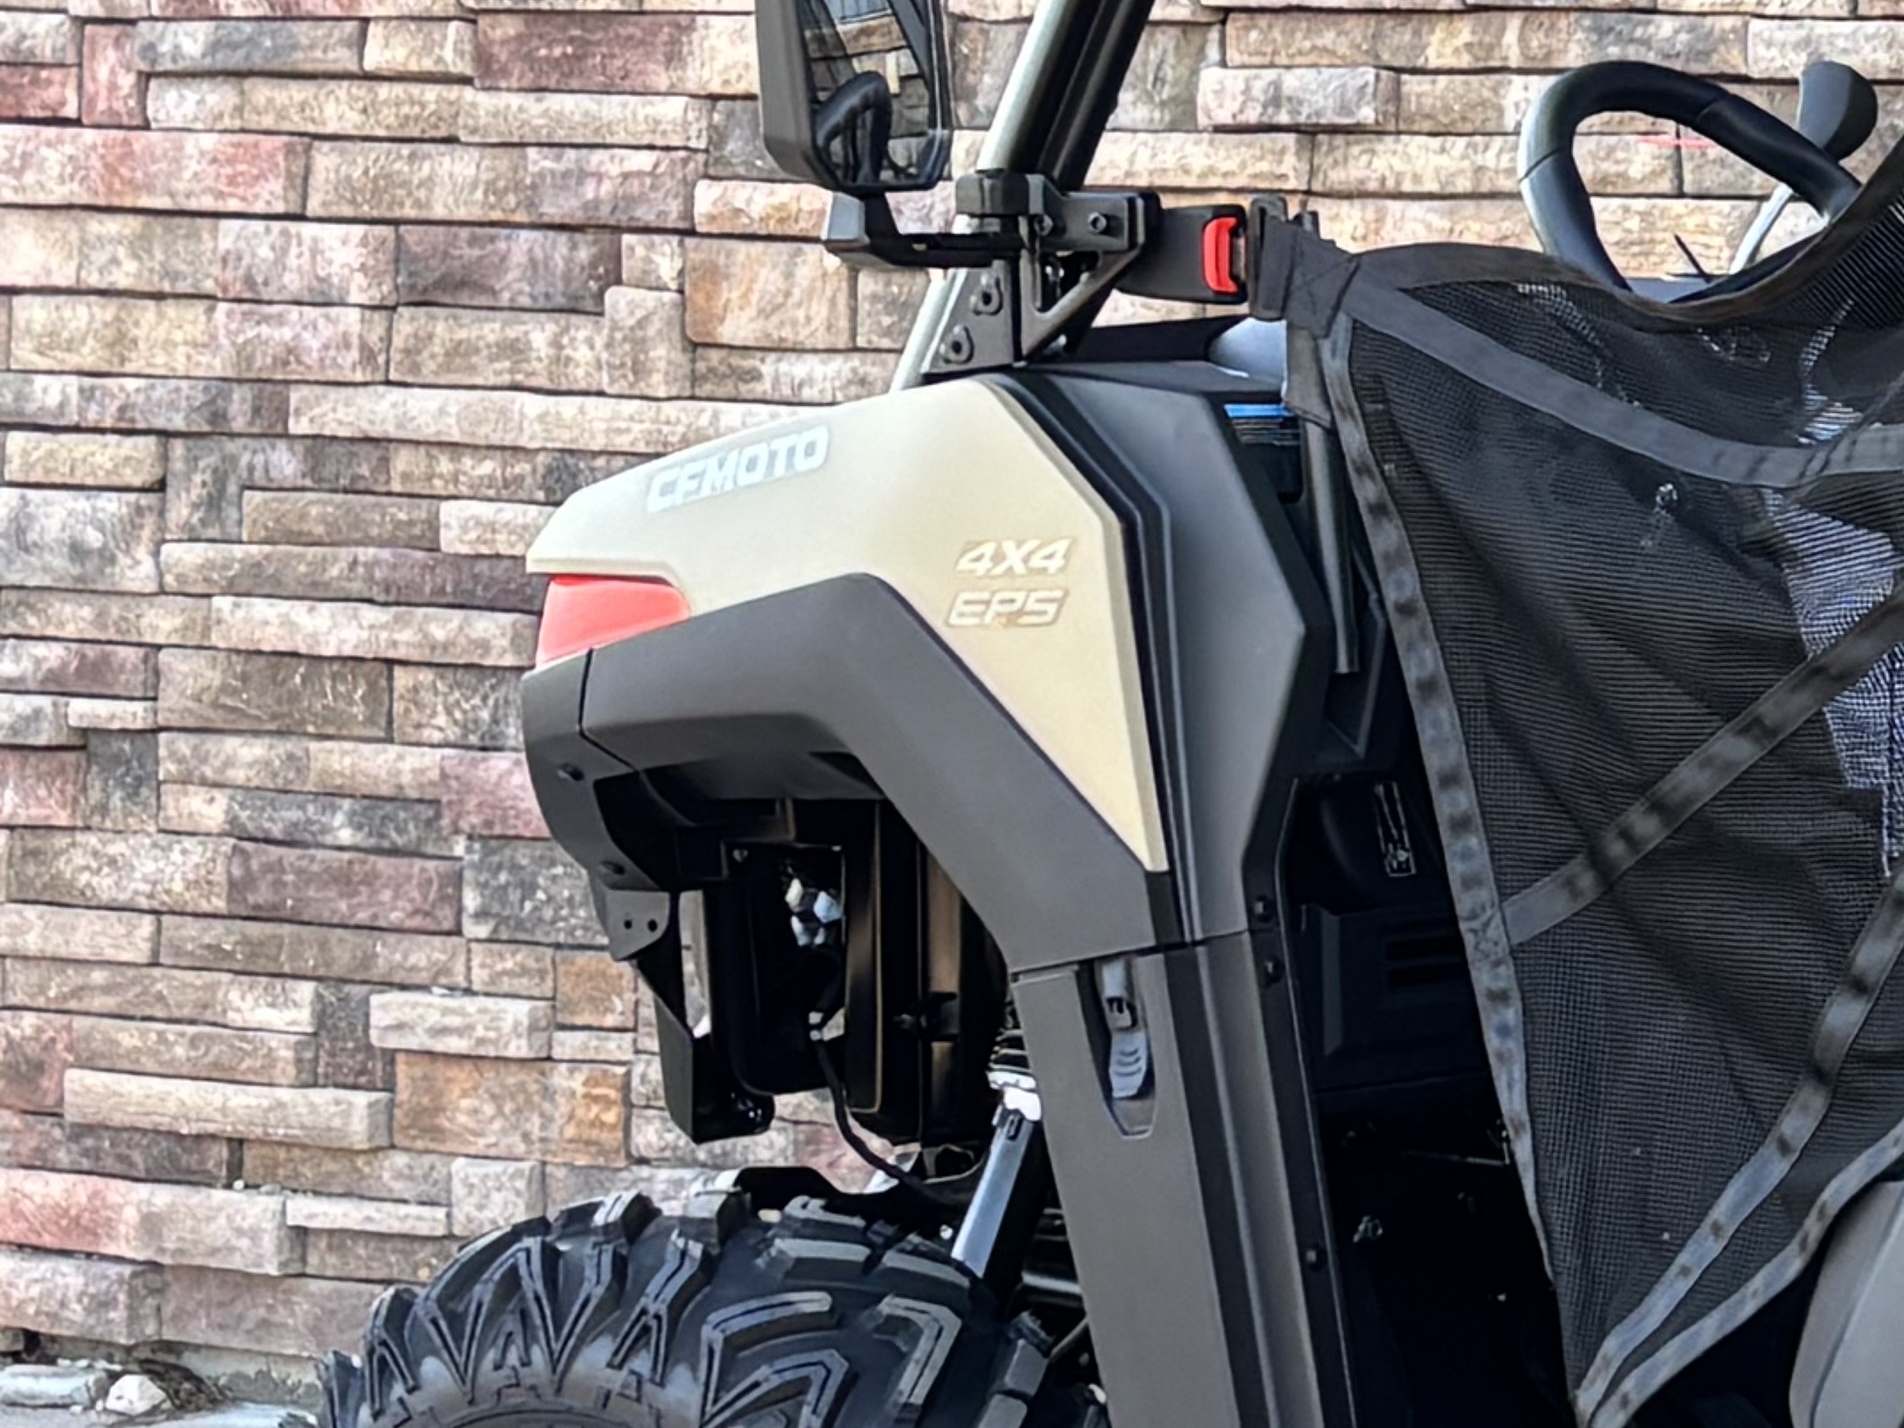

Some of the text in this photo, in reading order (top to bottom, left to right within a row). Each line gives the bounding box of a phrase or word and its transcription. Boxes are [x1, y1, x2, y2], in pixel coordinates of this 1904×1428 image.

[647, 426, 828, 512] CFMOTO
[955, 538, 1073, 576] 4X4
[948, 590, 1066, 627] EPS
